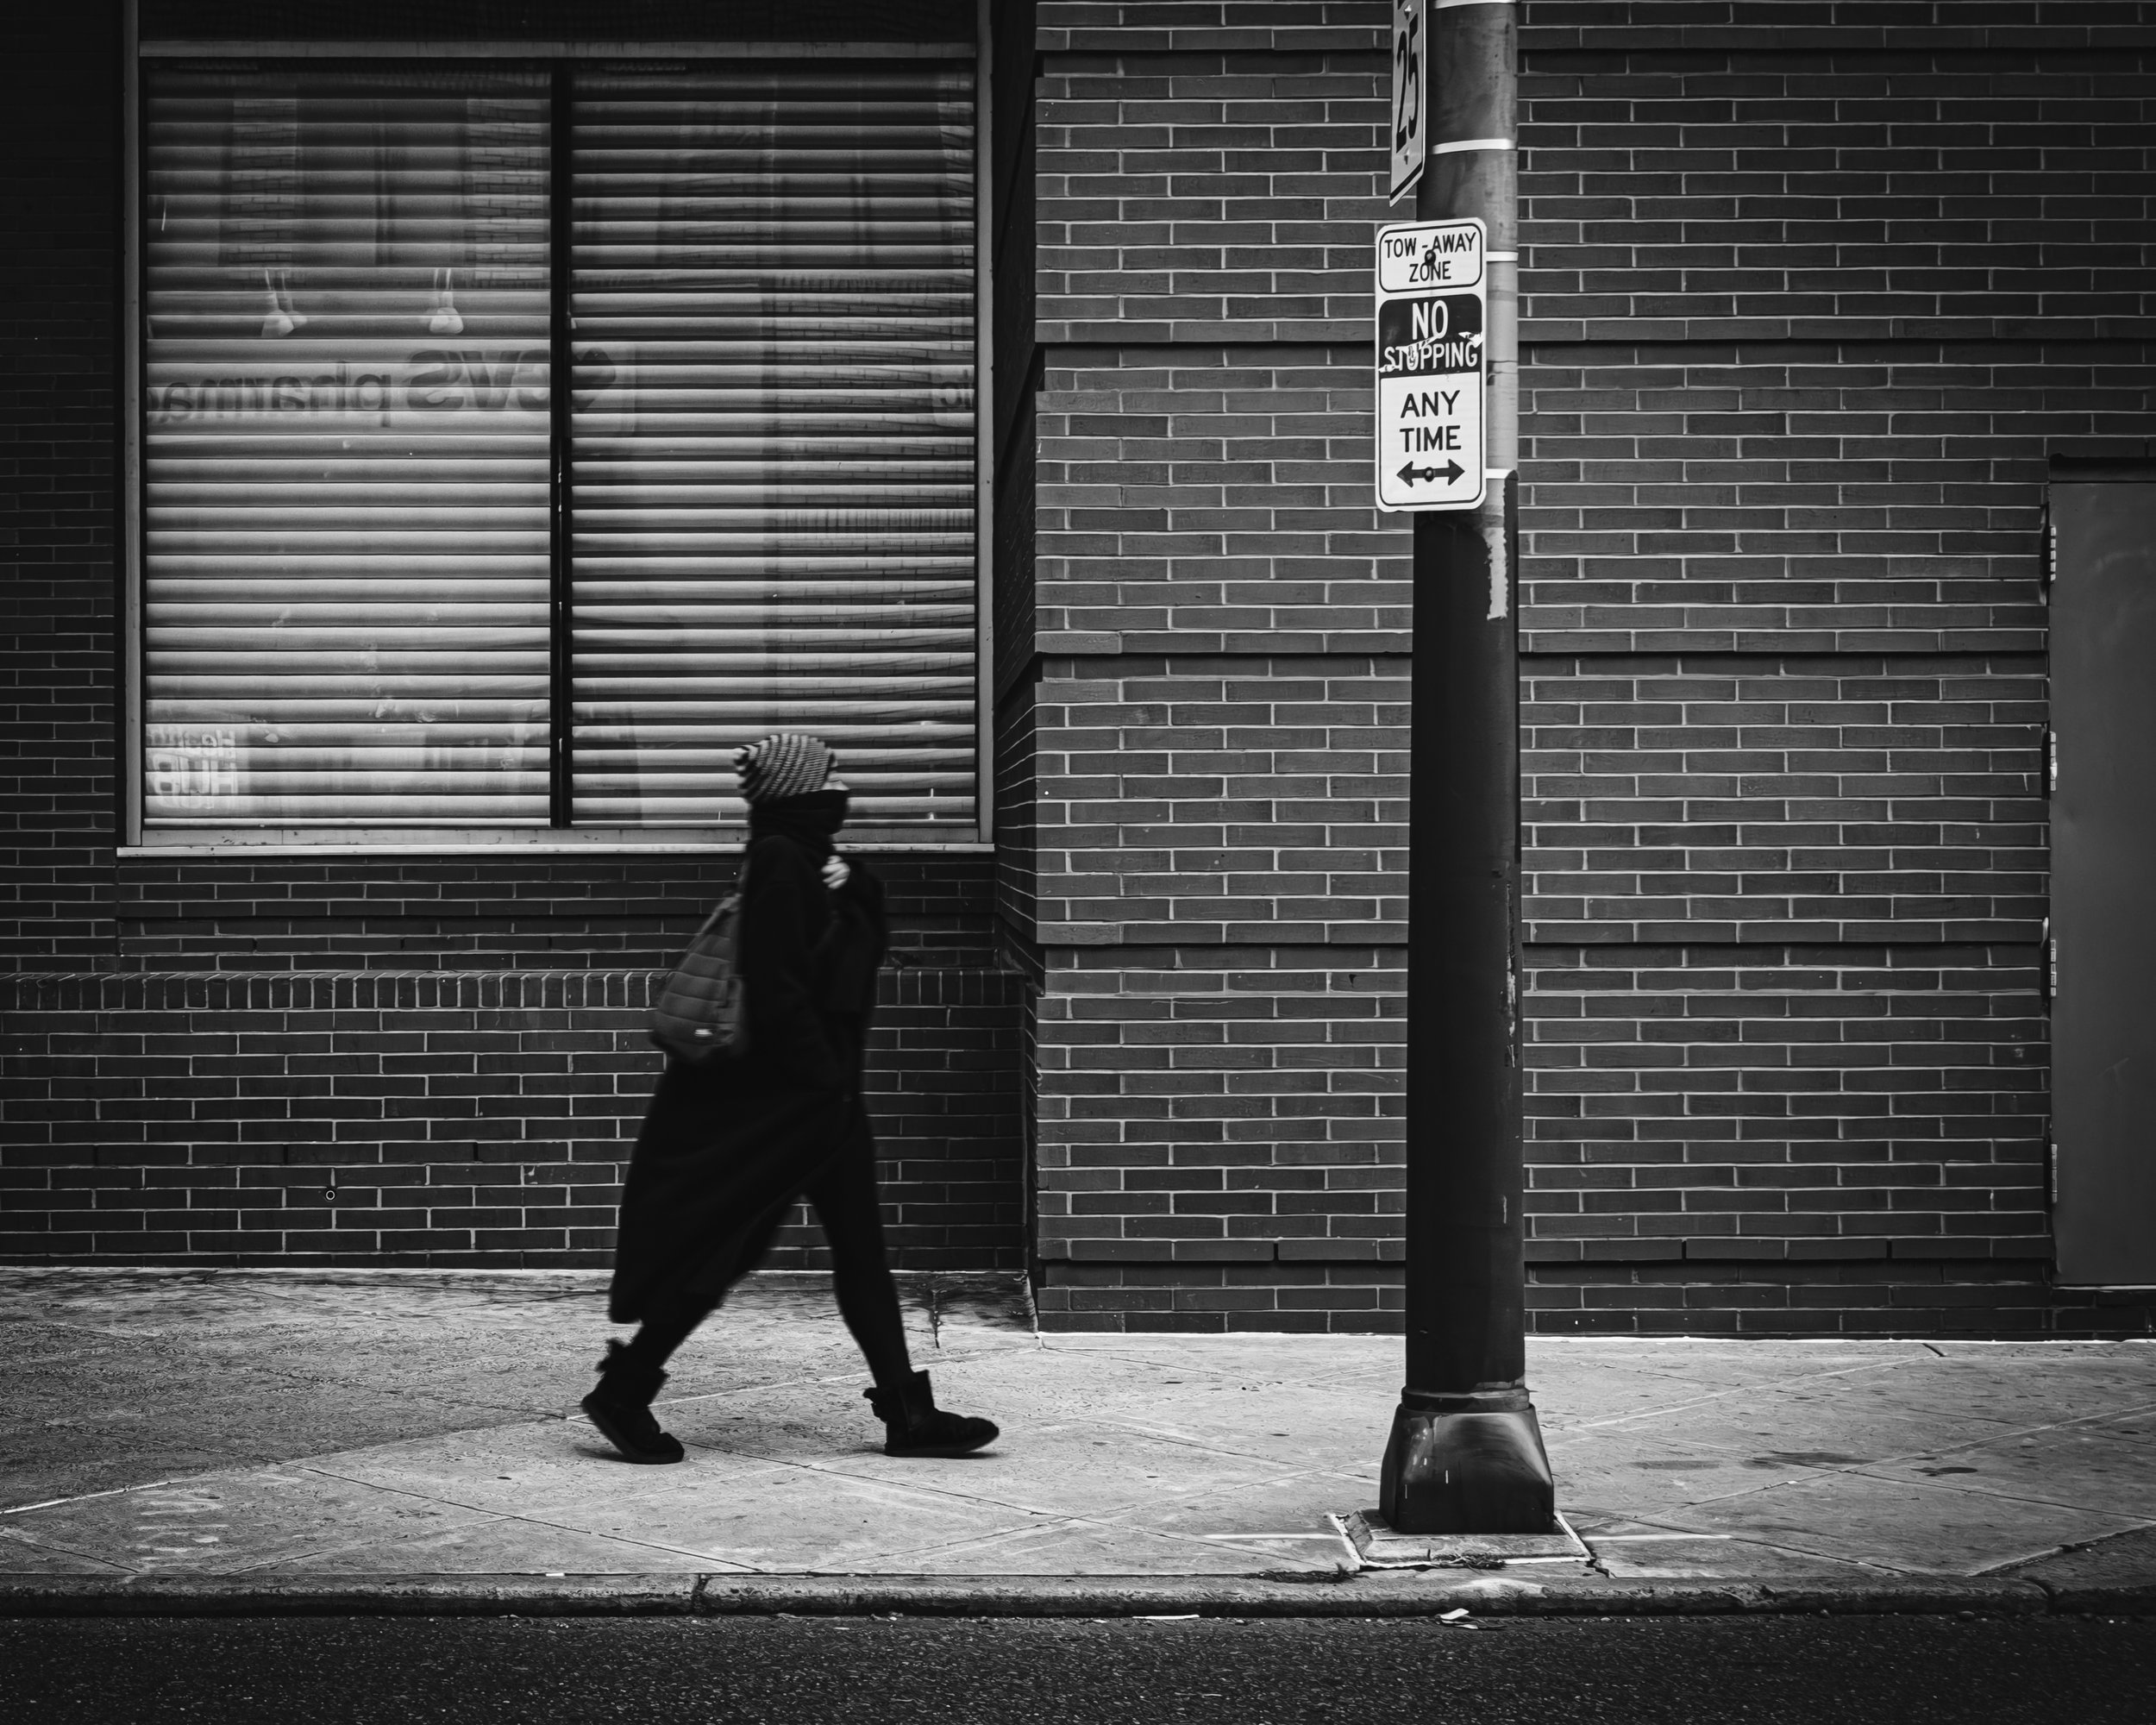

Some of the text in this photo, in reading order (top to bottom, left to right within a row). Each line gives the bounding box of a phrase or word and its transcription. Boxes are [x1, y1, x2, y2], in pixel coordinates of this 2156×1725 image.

[1396, 13, 1420, 154] 25
[1408, 260, 1451, 283] ZONE
[1412, 299, 1449, 341] NO
[1383, 341, 1478, 372] STOPPING
[1400, 390, 1461, 418] ANY
[1399, 424, 1462, 453] TIME
